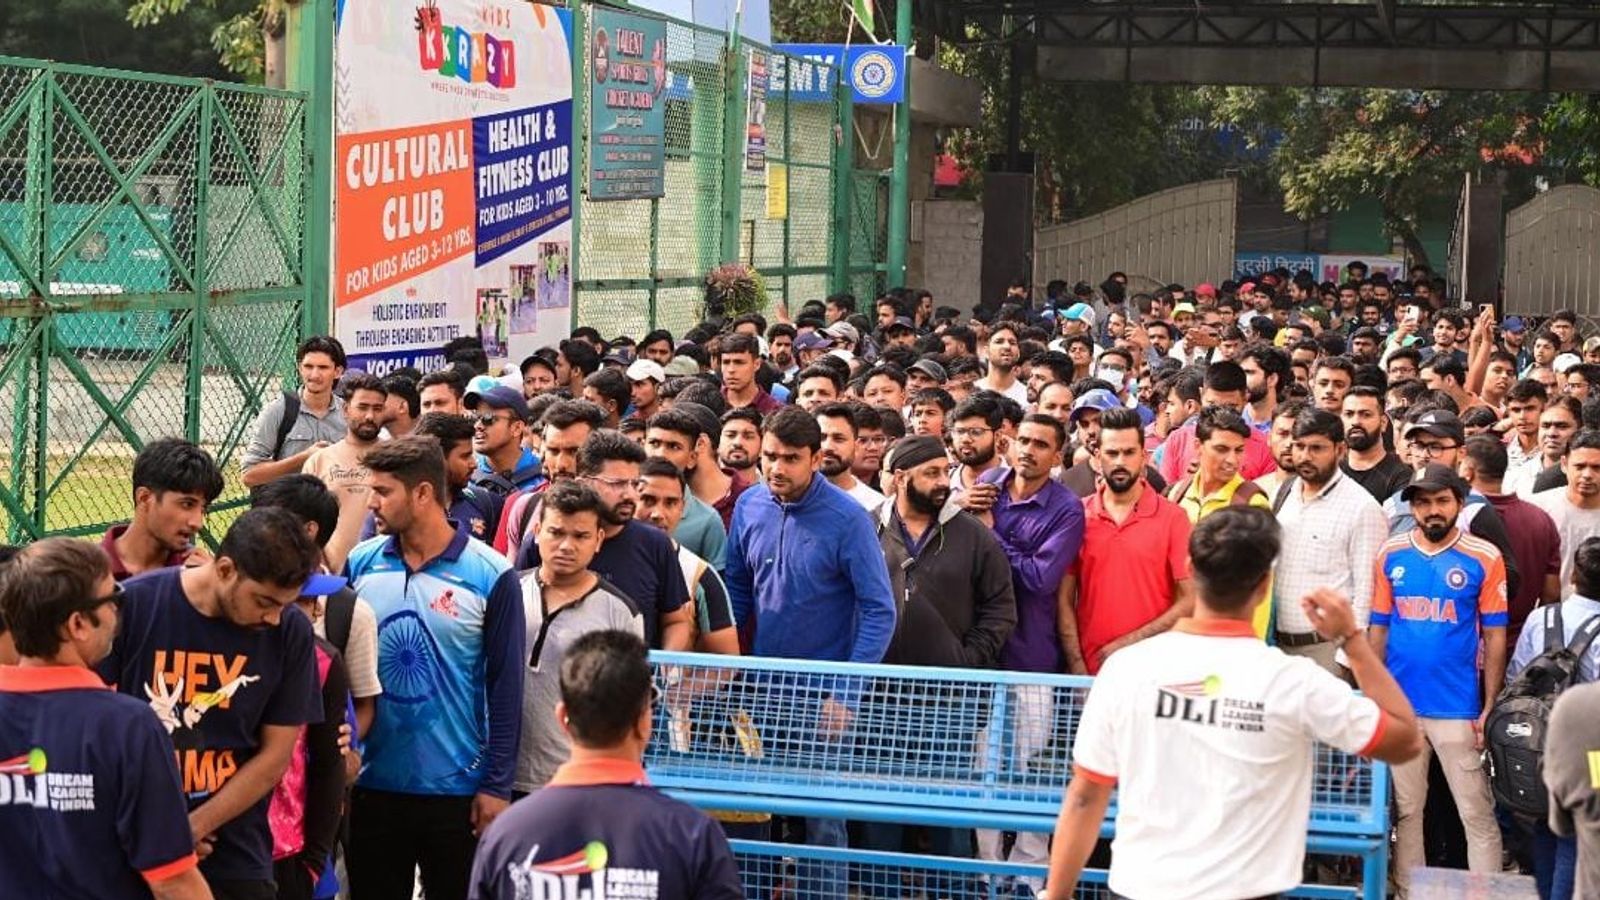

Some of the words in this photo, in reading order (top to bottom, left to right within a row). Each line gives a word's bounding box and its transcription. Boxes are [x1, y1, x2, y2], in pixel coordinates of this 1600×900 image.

[769, 54, 835, 92] EMY
[488, 112, 541, 154] HEALTH
[545, 109, 556, 140] &
[346, 129, 469, 189] CULTURAL
[479, 154, 533, 199] FITNESS
[537, 145, 569, 183] CLUB
[383, 190, 444, 241] CLUB
[479, 206, 496, 227] FOR
[495, 201, 514, 222] KIDS
[514, 195, 534, 217] AGED
[535, 193, 540, 210] 3
[546, 188, 555, 207] 10
[346, 267, 370, 295] FOR
[372, 255, 398, 285] KIDS
[400, 244, 429, 273] AGED
[431, 234, 453, 260] 3-12
[454, 225, 474, 250] YRS.
[373, 304, 404, 322] HOLISTIC
[356, 329, 390, 348] THROUGH
[391, 326, 426, 345] ENGAGING
[1394, 595, 1459, 624] INDIA
[152, 650, 248, 709] HEY
[1155, 688, 1219, 725] DLI
[1221, 710, 1265, 723] LEAGUE
[1222, 697, 1266, 712] DREAM
[47, 773, 94, 787] DREAM
[174, 749, 238, 794] MA
[49, 786, 95, 799] LEAGUE
[530, 869, 606, 900] DLI
[607, 867, 659, 884] DREAM
